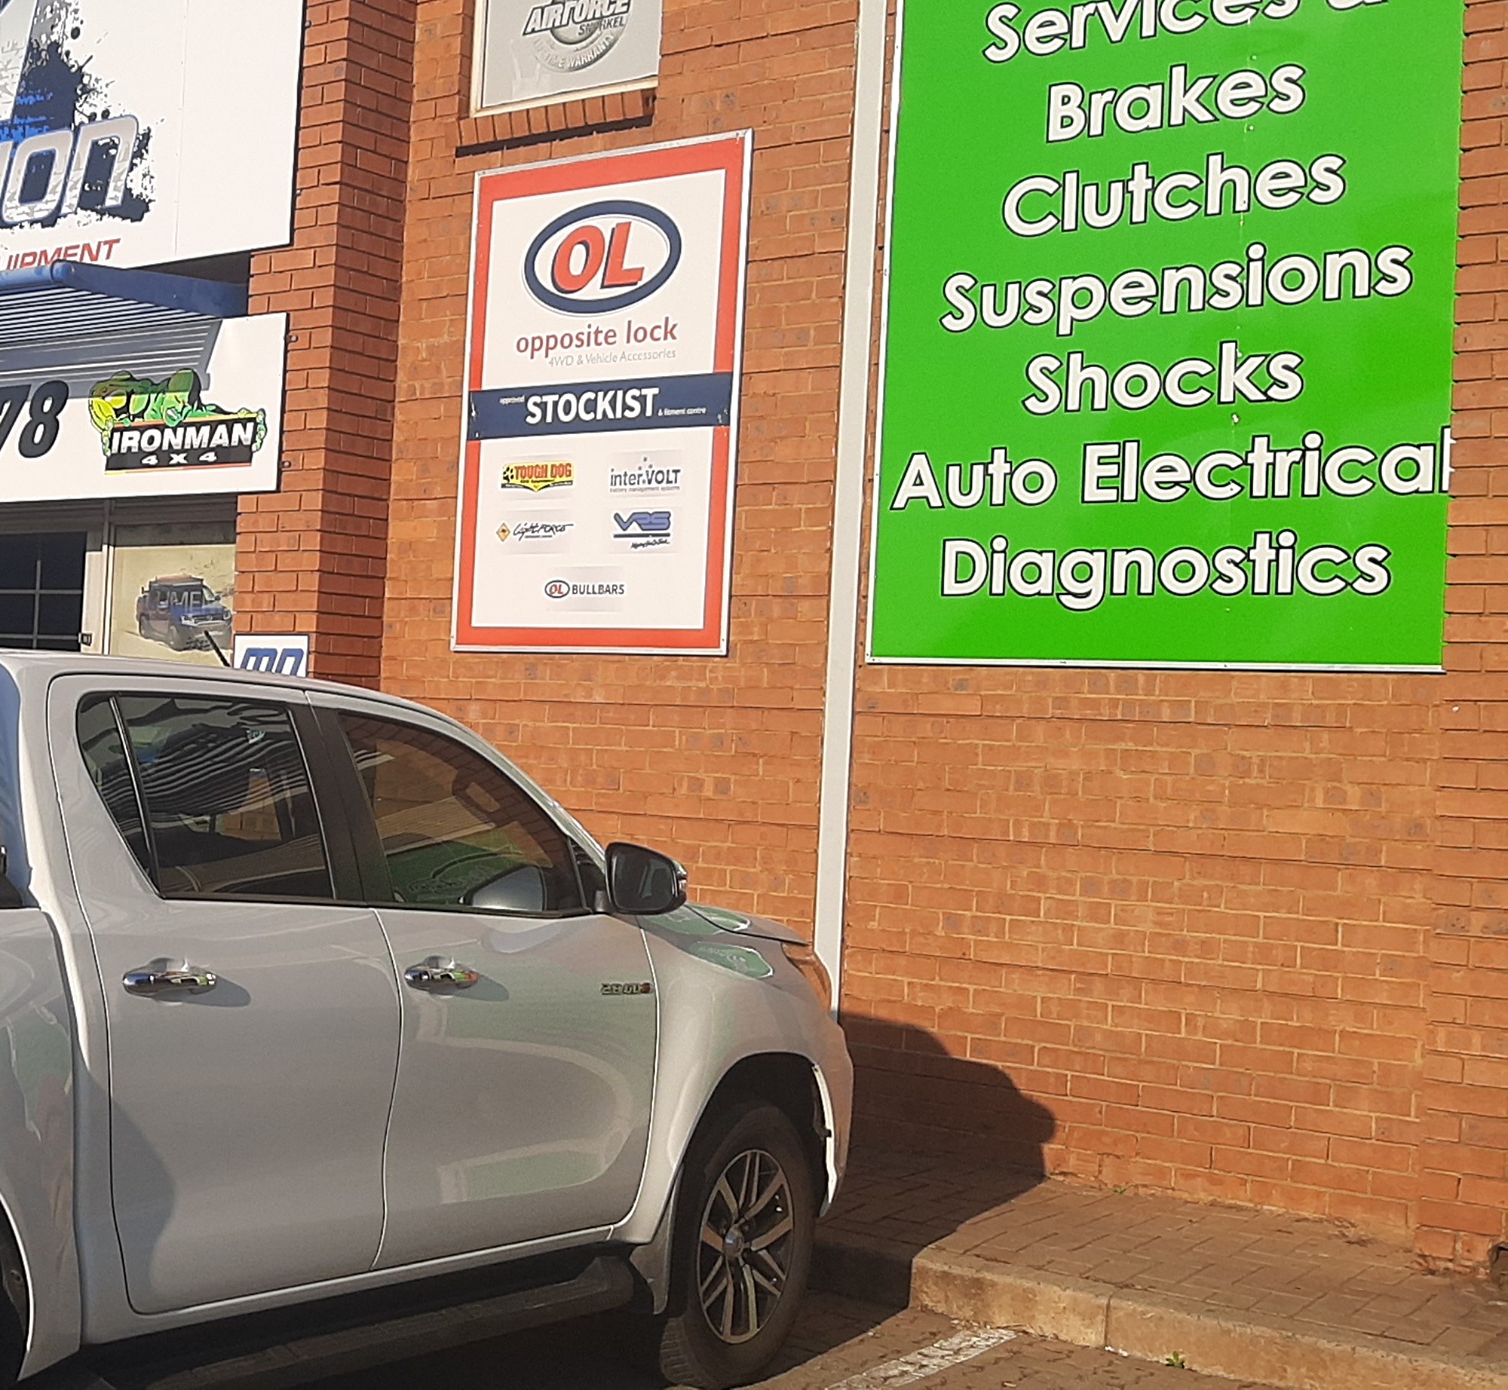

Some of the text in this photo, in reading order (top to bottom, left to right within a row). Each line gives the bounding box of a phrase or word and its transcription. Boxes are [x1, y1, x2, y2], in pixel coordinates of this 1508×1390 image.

[1046, 62, 1307, 143] Brakes
[1002, 152, 1348, 238] Clutches
[550, 220, 646, 295] OL
[940, 242, 1415, 337] Suspensions
[516, 316, 679, 360] opposite lock
[548, 348, 678, 368] 4WD & Vehicle Accessories
[525, 387, 660, 425] STOCKIST
[1022, 340, 1305, 416] Shocks
[111, 421, 255, 454] IRONMAN
[514, 462, 573, 480] TOUGH DOG
[889, 425, 1451, 511] Auto Electrical
[548, 583, 625, 595] OL BULLBARS
[940, 528, 1393, 613] Diagnostics
